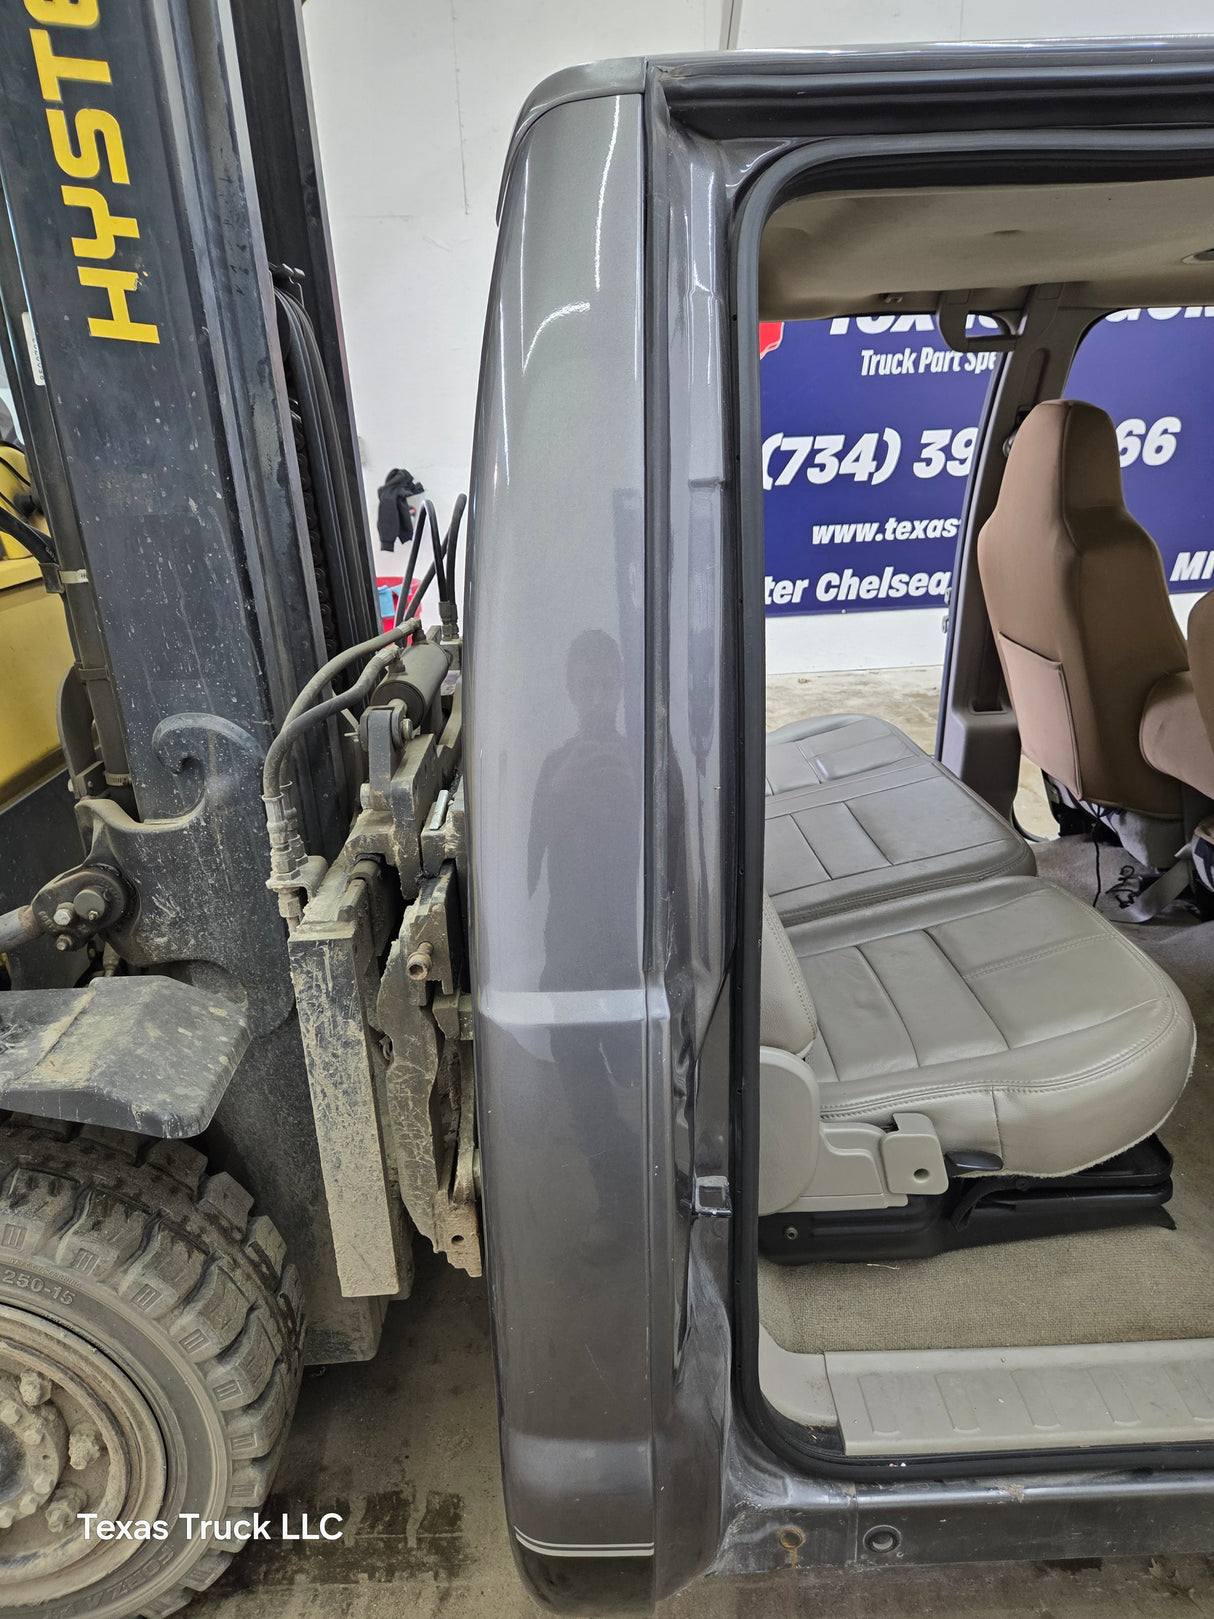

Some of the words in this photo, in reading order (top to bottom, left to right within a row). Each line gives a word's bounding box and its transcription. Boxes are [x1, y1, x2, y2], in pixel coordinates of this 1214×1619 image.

[861, 347, 918, 376] Truck
[918, 347, 964, 373] Part
[762, 427, 902, 491] (734)
[912, 427, 979, 478] 39
[1115, 416, 1182, 468] 66
[812, 517, 962, 545] www.texas
[816, 566, 952, 602] Chelsea
[2, 1269, 77, 1306] 250-15
